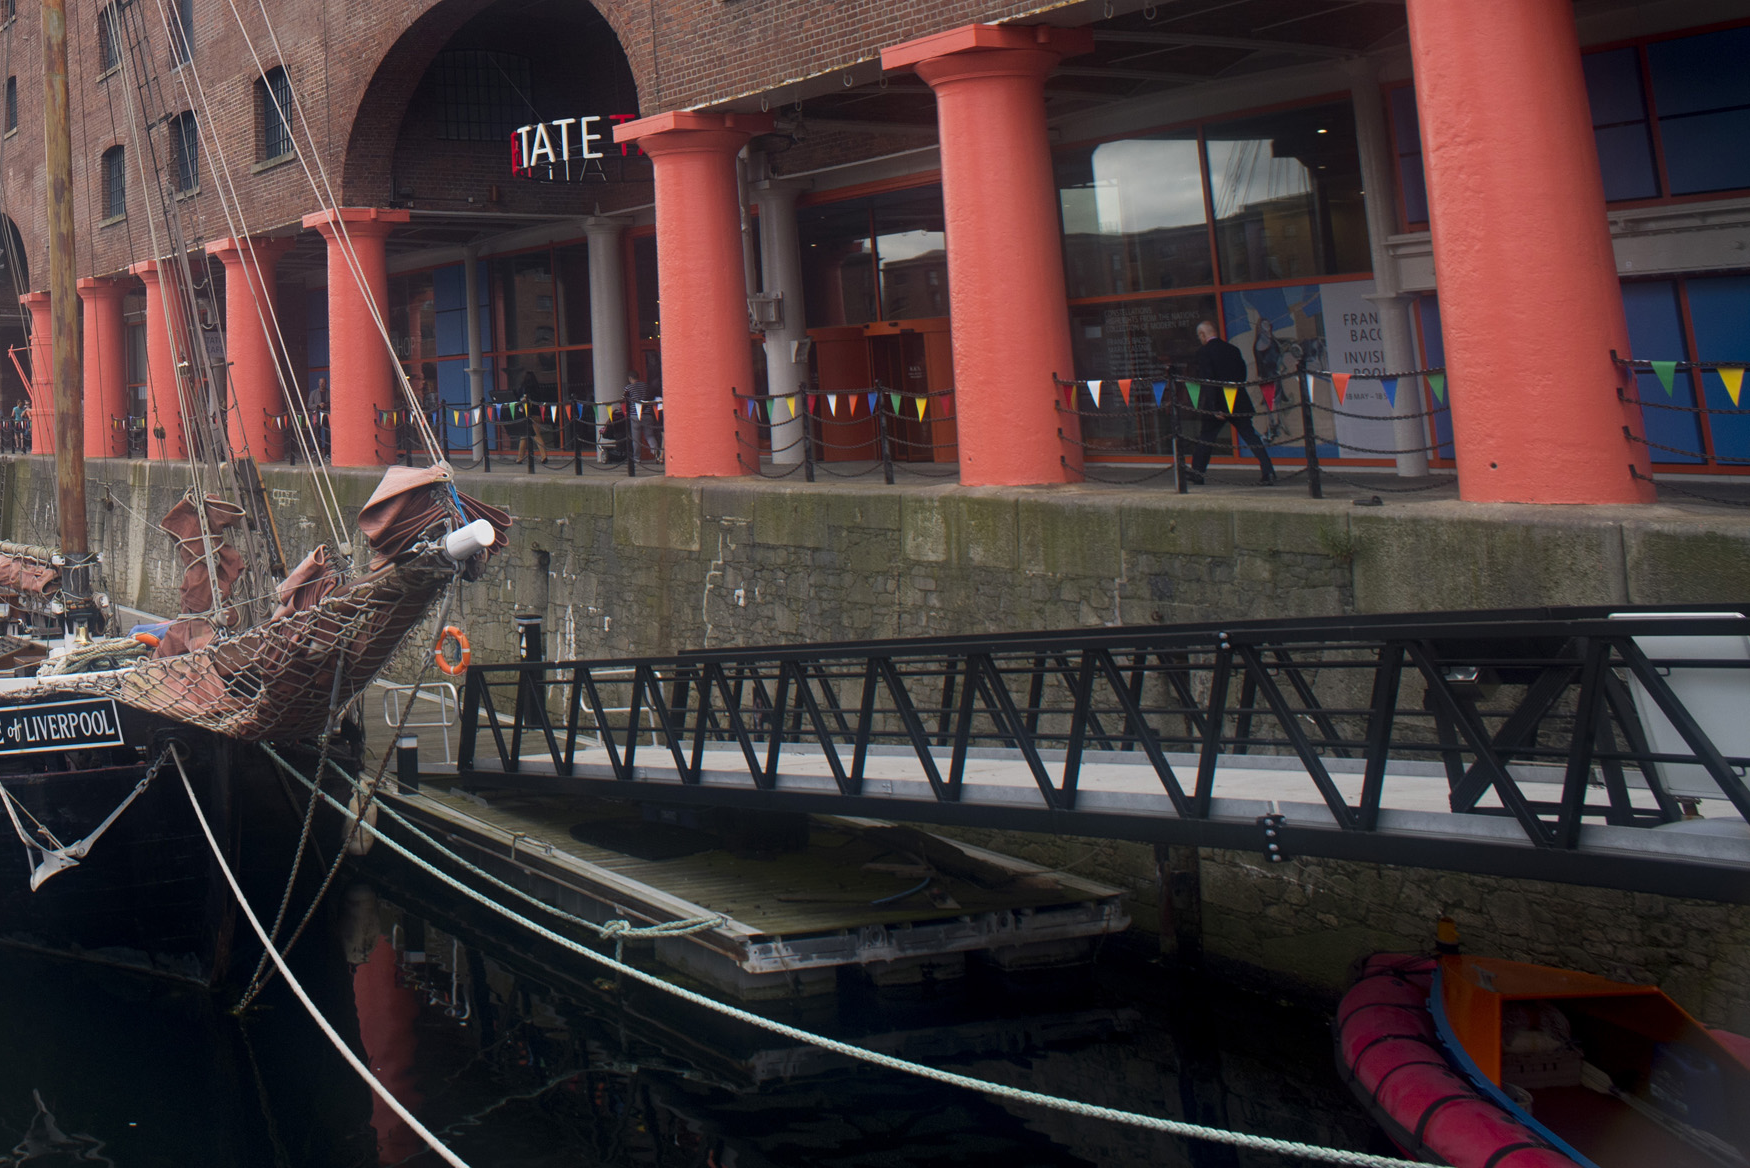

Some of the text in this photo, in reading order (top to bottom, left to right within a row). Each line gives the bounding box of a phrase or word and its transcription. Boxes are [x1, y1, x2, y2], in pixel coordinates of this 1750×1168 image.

[517, 115, 604, 168] TATE
[1343, 312, 1378, 326] FRAN
[1353, 392, 1369, 400] MAY
[7, 718, 21, 743] of
[23, 709, 116, 743] LIVERPOOL
